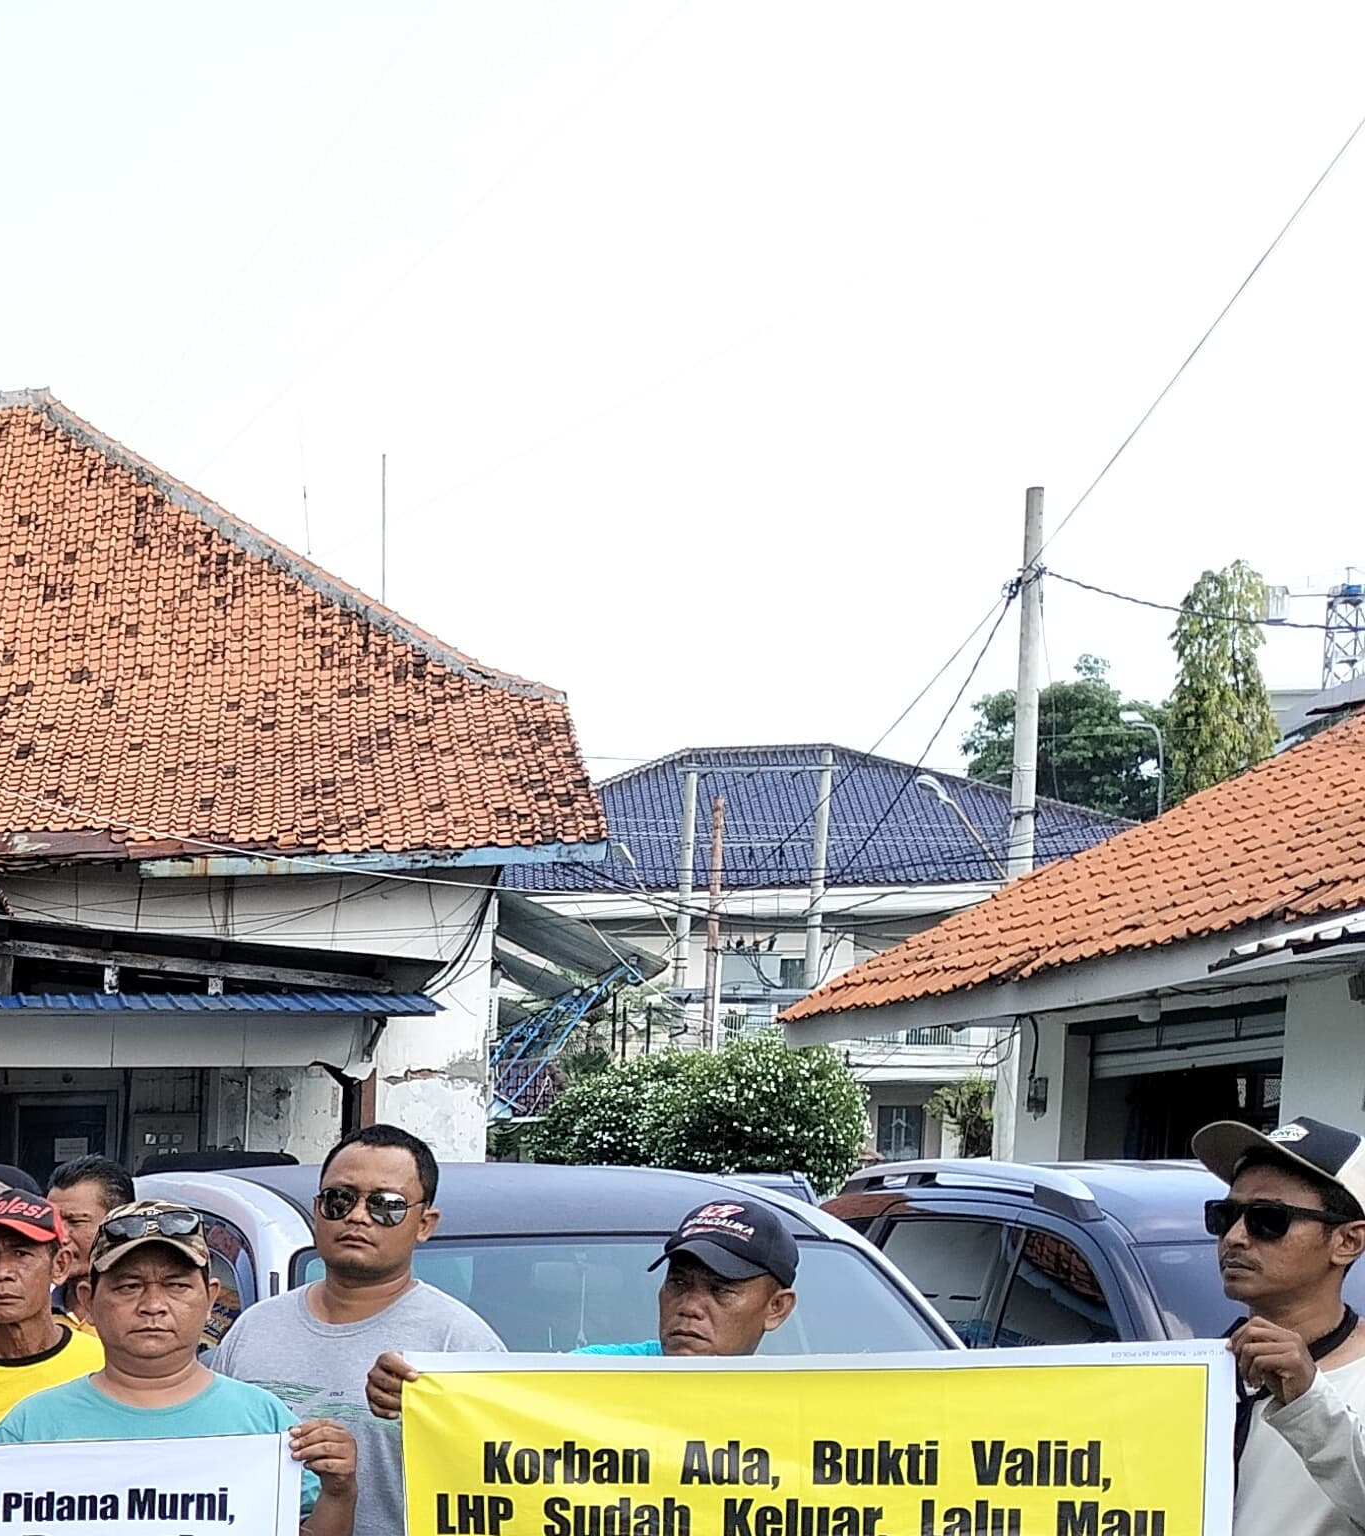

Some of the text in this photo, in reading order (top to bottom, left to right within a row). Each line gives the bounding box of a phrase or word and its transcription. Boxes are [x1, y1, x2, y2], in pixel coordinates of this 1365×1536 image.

[483, 1440, 1112, 1493] Korban Ada, Bukti Valid,
[2, 1491, 119, 1523] Pidana
[126, 1487, 236, 1526] Murni,
[436, 1493, 514, 1536] LHP
